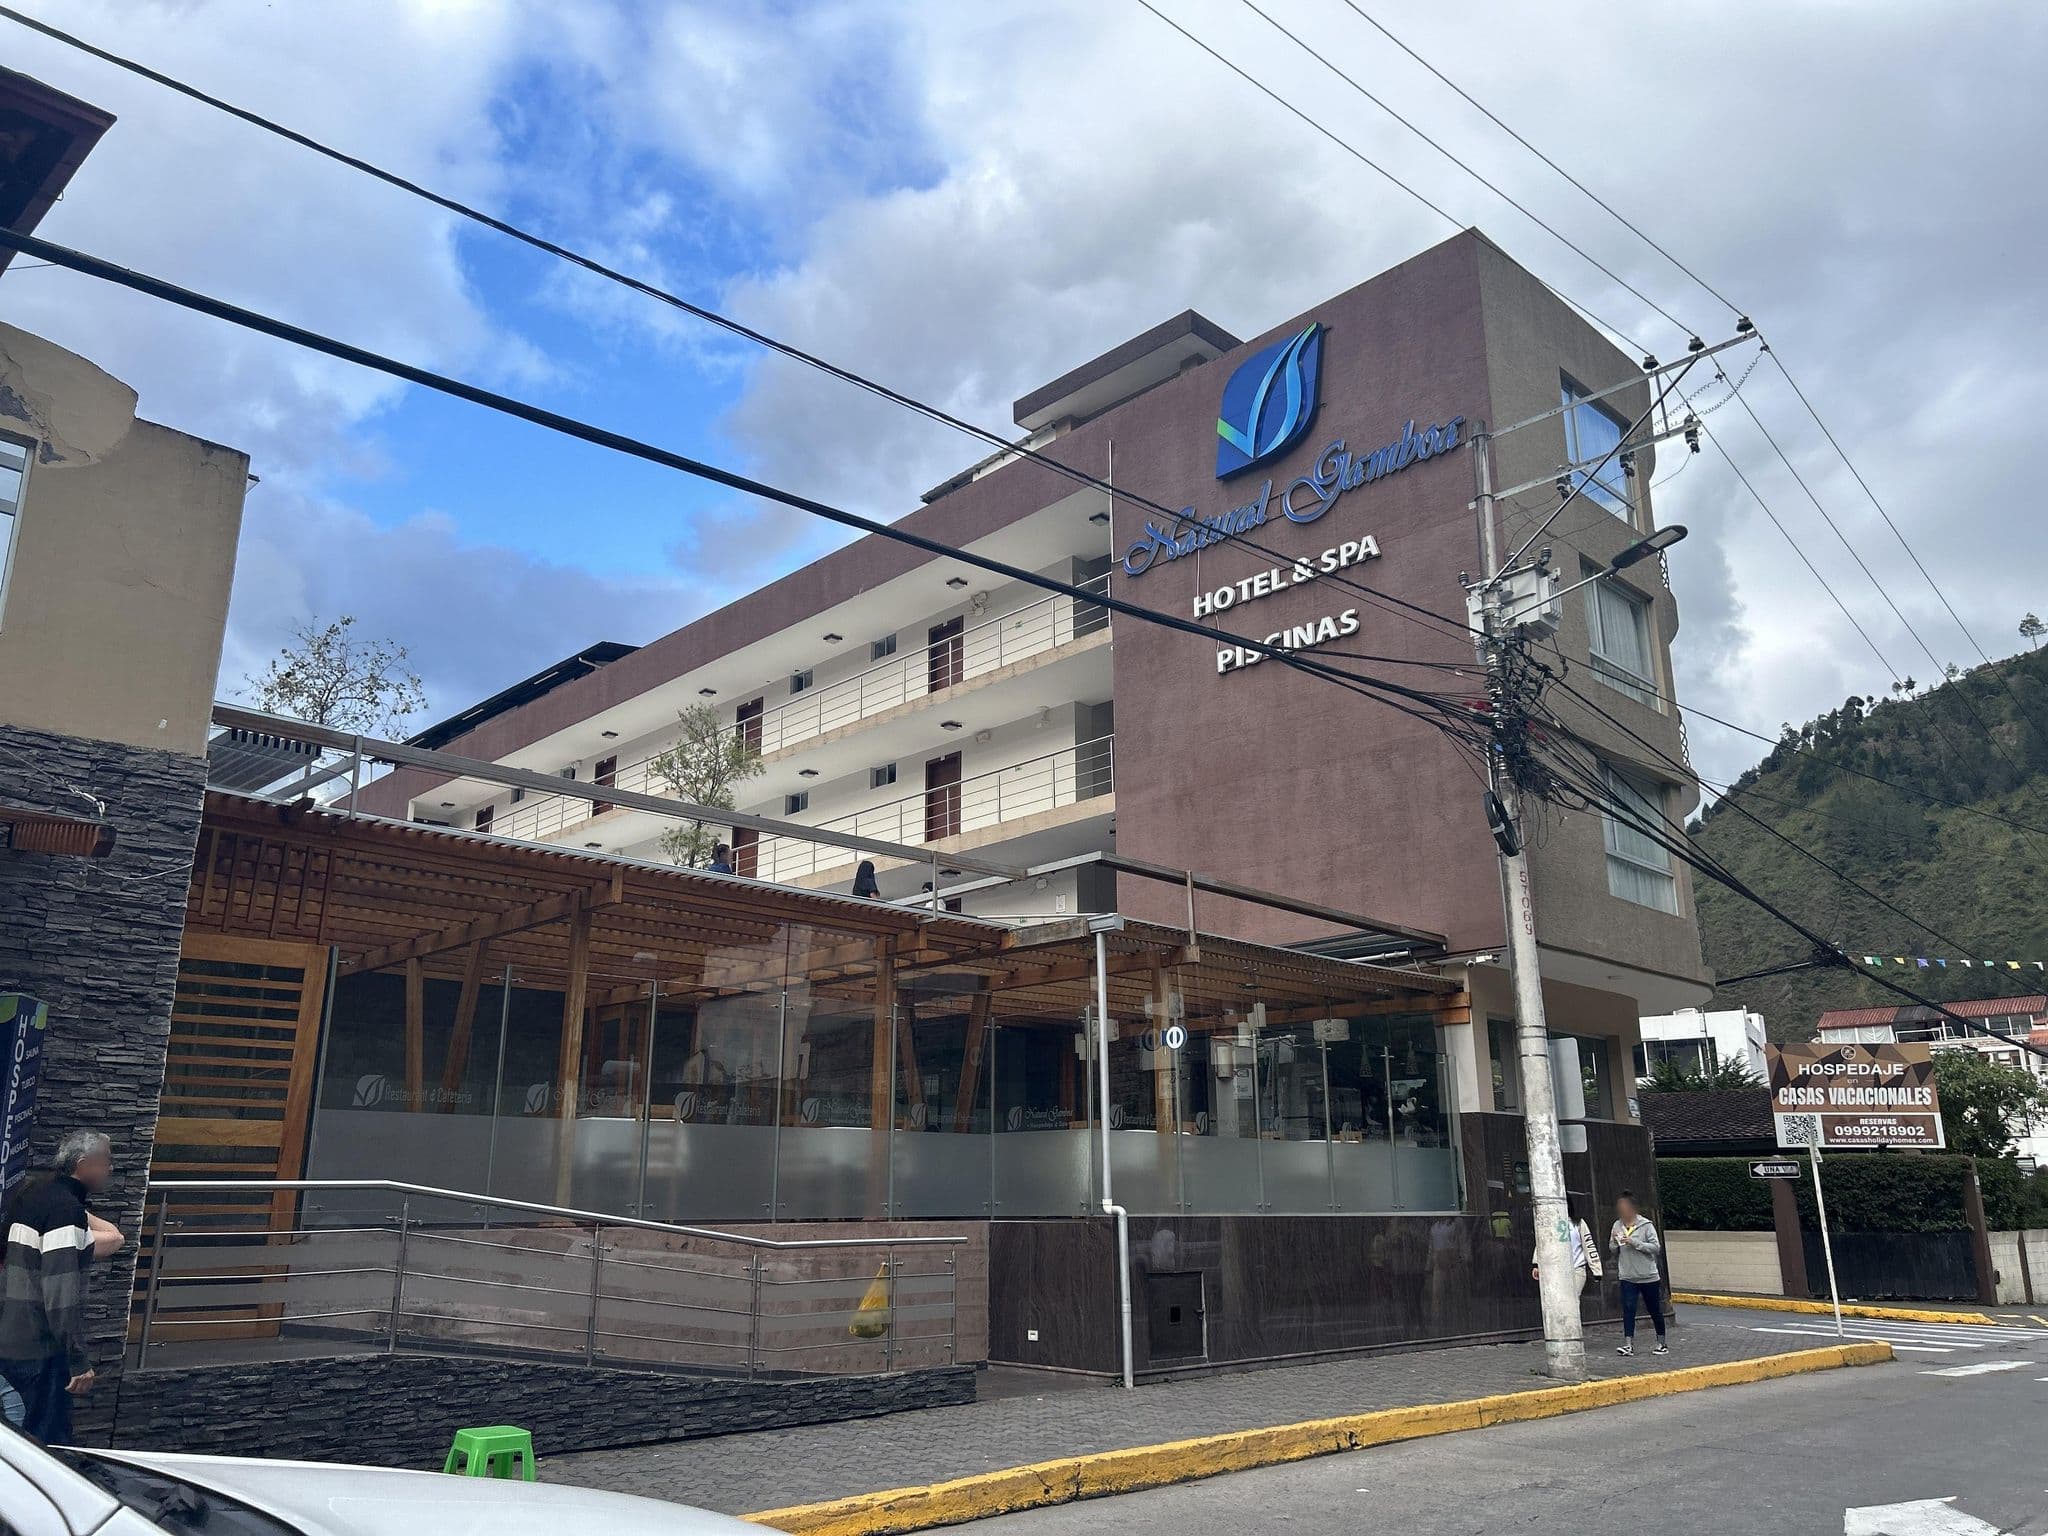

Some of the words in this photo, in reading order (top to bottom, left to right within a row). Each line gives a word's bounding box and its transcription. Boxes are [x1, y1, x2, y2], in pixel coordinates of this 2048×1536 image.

[1123, 480, 1273, 578] Natural
[1282, 415, 1466, 524] Gamboa
[1193, 567, 1289, 619] HOTEL
[1292, 556, 1316, 583] &
[1320, 534, 1381, 574] SPA
[1217, 608, 1361, 675] PISCINAS
[1798, 1063, 1904, 1076] HOSPEDAJE
[1778, 1086, 1825, 1106] CASAS
[1828, 1086, 1932, 1106] VACACIONALES
[1834, 1126, 1926, 1136] 0999218902
[1829, 1137, 1934, 1145] www.casasholidayhomes.com
[1764, 1166, 1781, 1174] UNA
